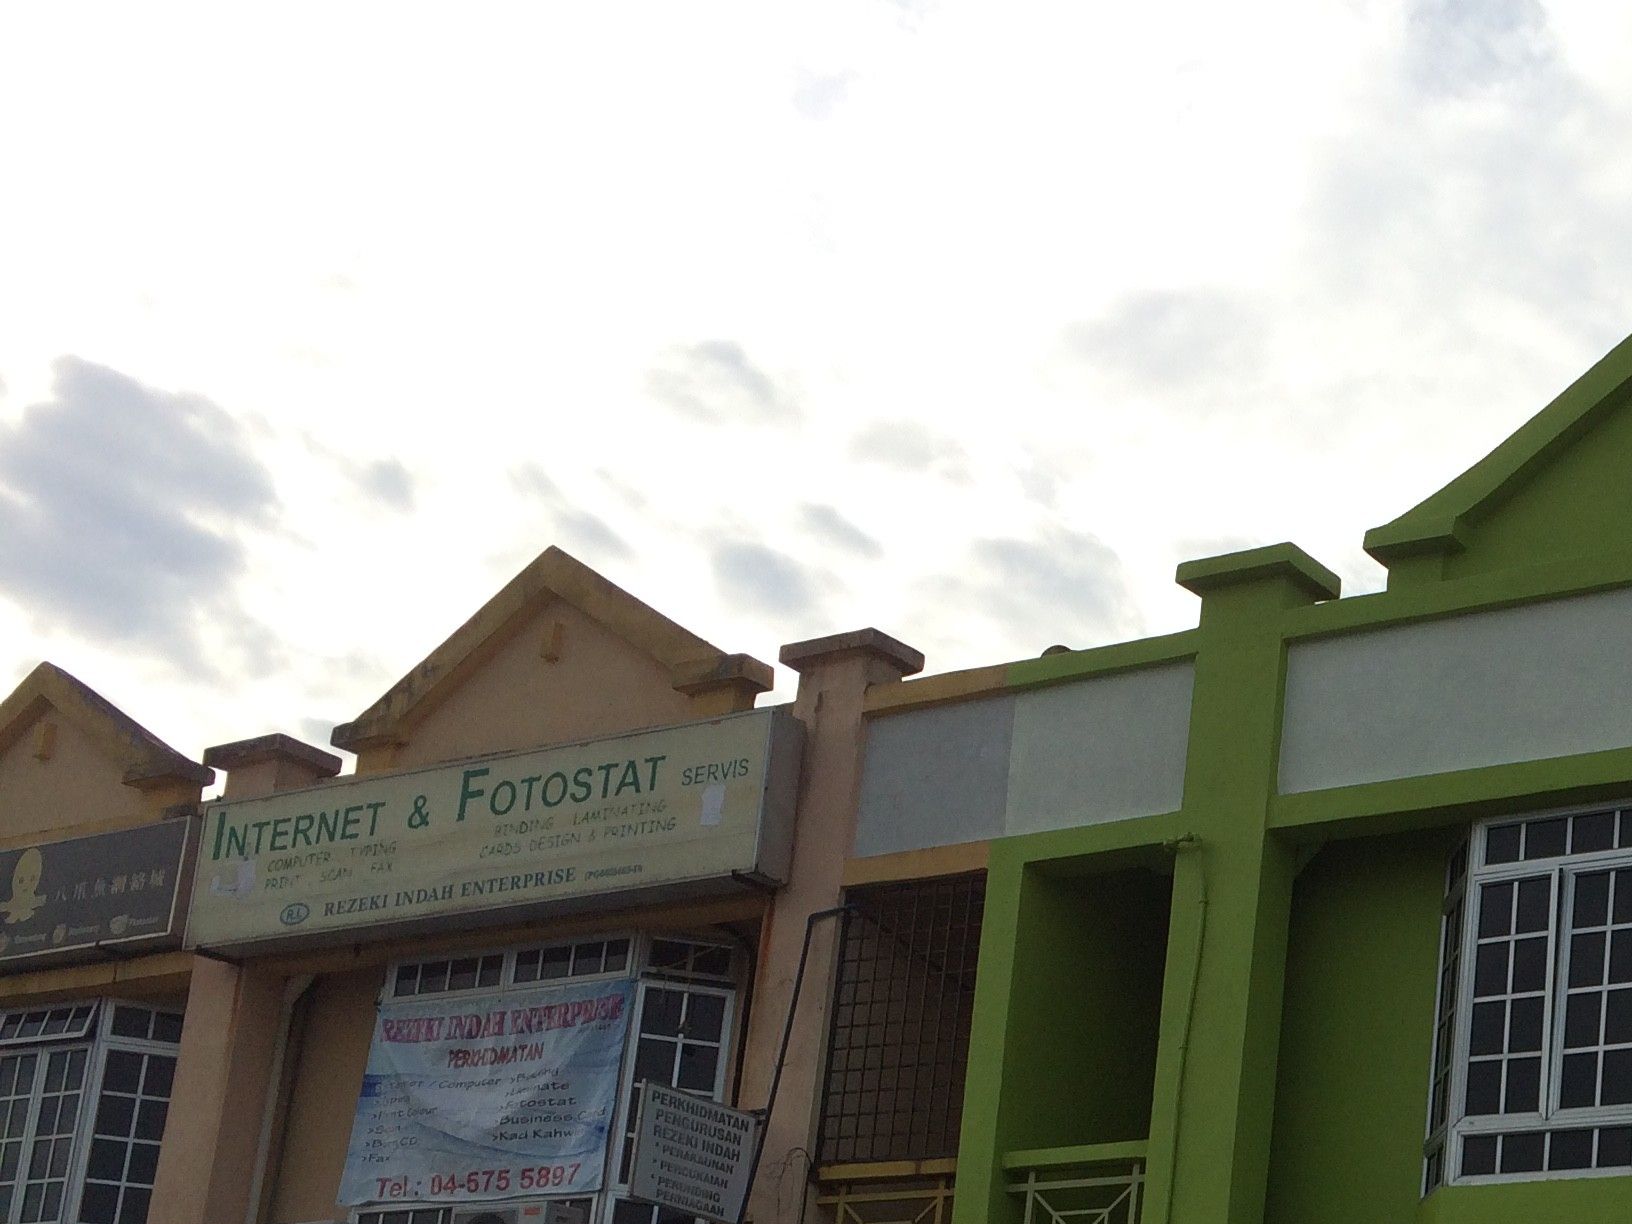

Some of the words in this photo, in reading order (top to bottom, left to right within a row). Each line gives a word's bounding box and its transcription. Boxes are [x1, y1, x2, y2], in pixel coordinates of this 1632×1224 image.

[212, 802, 386, 860] INTERNET
[408, 795, 430, 829] &
[456, 755, 666, 822] FOTOSTAT
[681, 759, 749, 786] SERVIS
[529, 832, 581, 853] DESIGN
[604, 816, 676, 838] PRINTING
[267, 851, 331, 872] COMPUTER
[324, 894, 387, 917] REZEKI
[394, 884, 453, 907] INDAH
[460, 867, 577, 898] ENTERPRISE
[381, 1017, 444, 1043] REZEKI
[445, 1011, 507, 1040] INDAH
[509, 993, 625, 1034] ENTERPRISE
[448, 1042, 544, 1068] PERKHIDMATAN
[439, 1076, 502, 1090] Computer
[652, 1090, 749, 1132] PERKHIDMATAN
[656, 1108, 742, 1146] PENGURUSAN
[653, 1124, 698, 1149] REZEKI
[702, 1139, 740, 1162] INDAH
[662, 1144, 734, 1175] PERAKAUNAN
[520, 1163, 581, 1189] 5897
